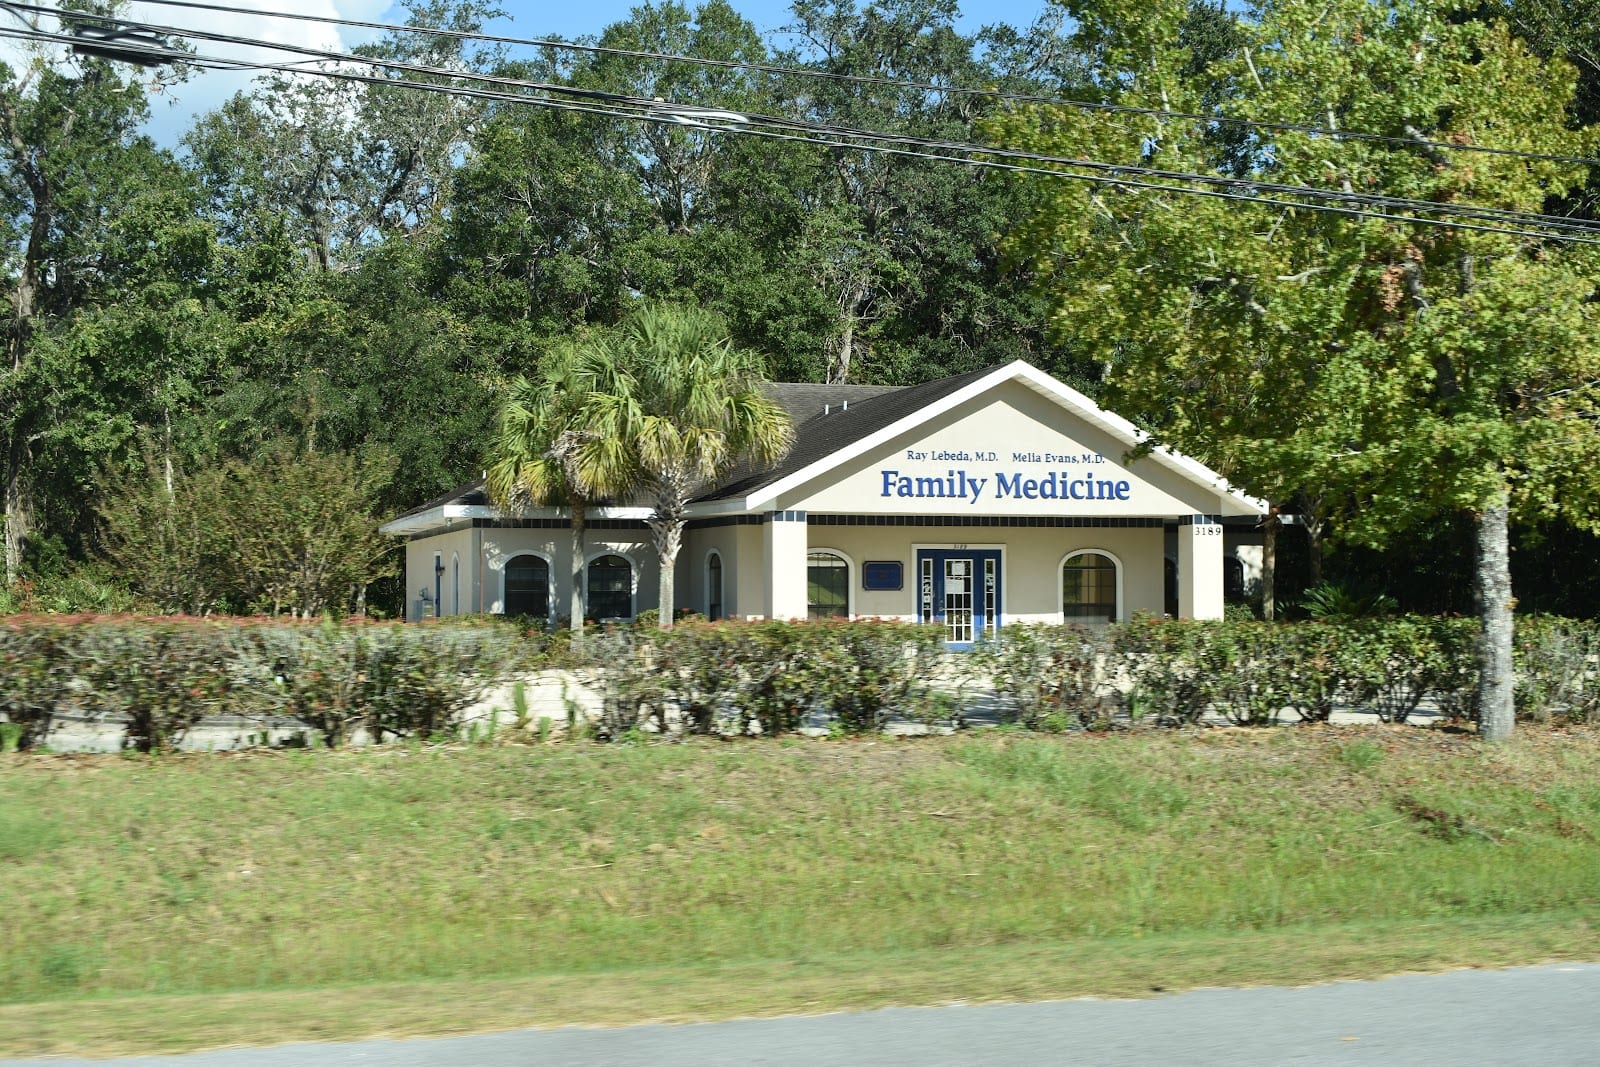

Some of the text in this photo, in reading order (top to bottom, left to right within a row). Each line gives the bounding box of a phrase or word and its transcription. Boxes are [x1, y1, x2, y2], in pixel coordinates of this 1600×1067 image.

[907, 450, 999, 462] Ray Lebeda, M.D.
[1012, 452, 1105, 464] Melia Evans, M.D.
[881, 470, 1130, 504] Family Medicine
[1194, 526, 1222, 536] 3189
